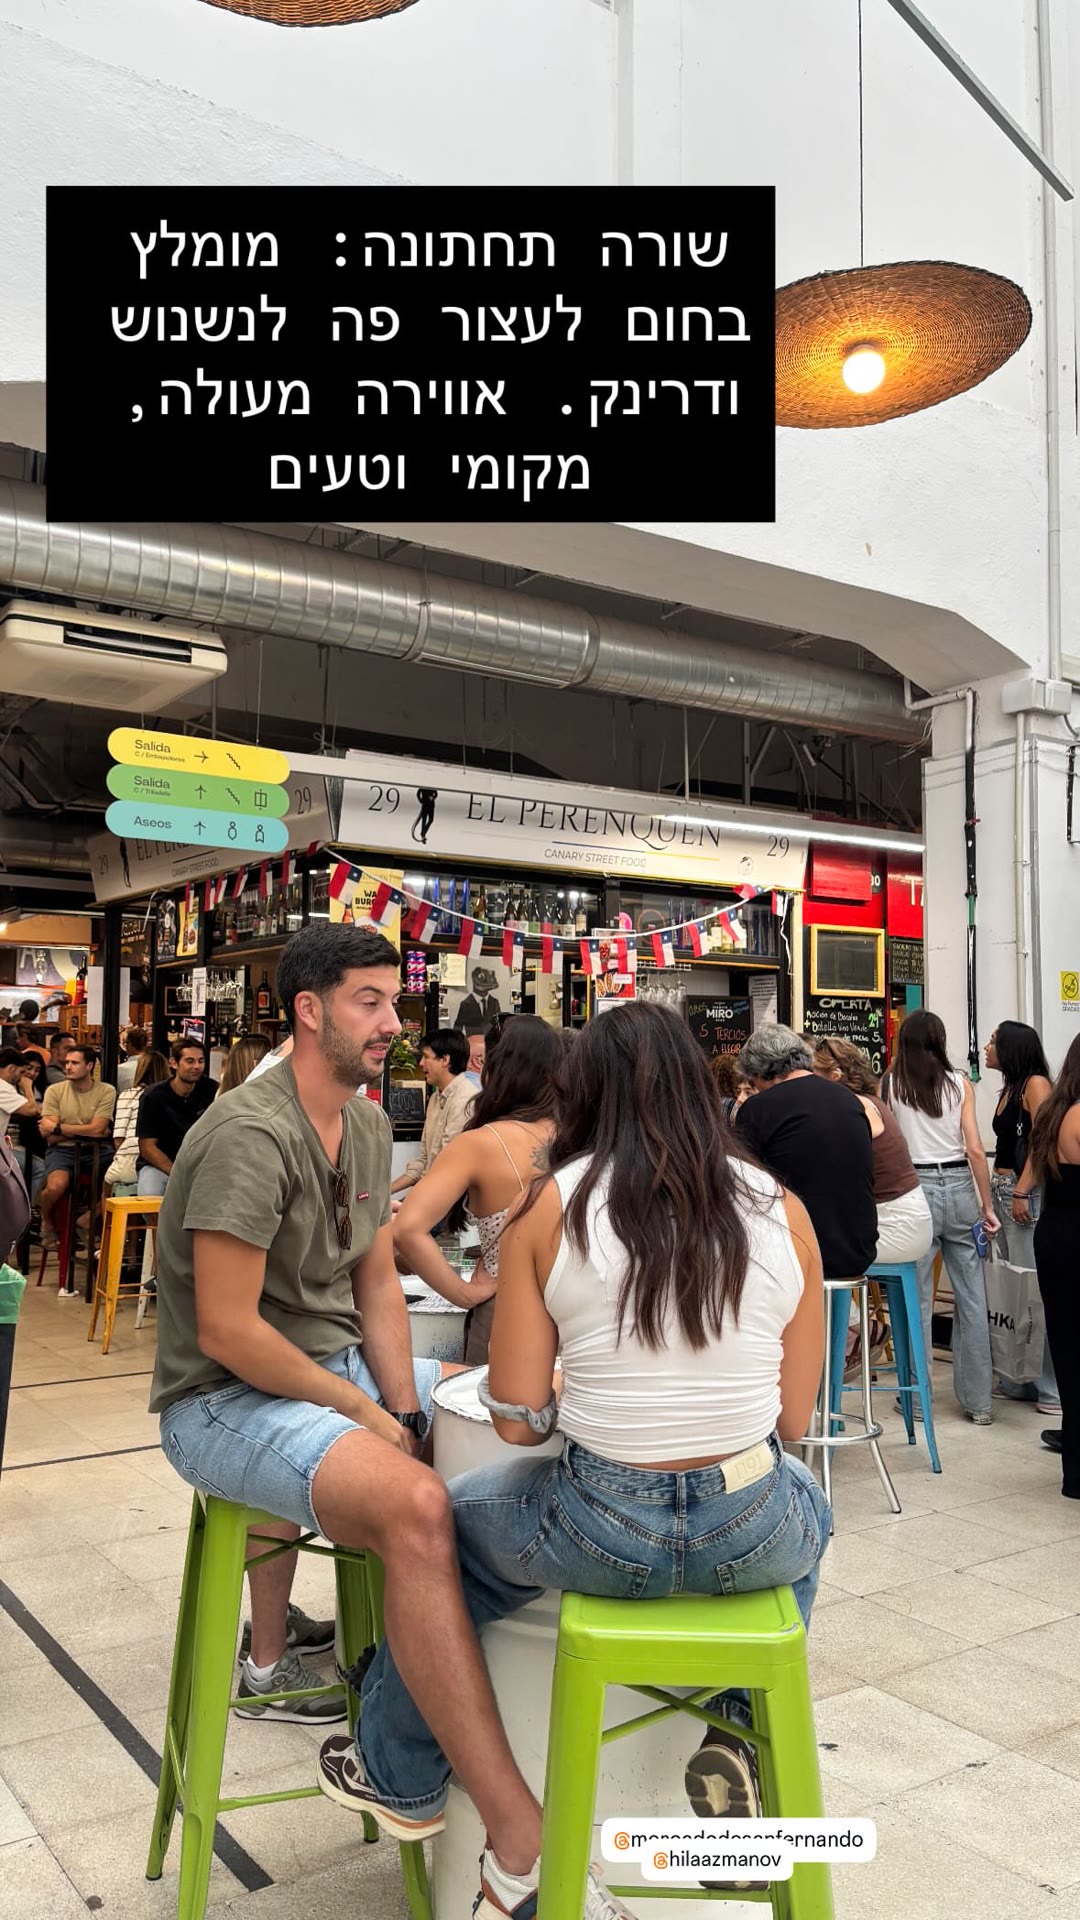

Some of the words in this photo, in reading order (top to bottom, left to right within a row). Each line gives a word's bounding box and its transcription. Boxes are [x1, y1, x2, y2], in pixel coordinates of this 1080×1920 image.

[135, 740, 171, 753] Salida
[134, 775, 170, 789] Salida
[294, 786, 311, 815] 29
[368, 785, 400, 814] 29
[134, 816, 172, 829] Aseos
[466, 793, 506, 823] EL
[517, 800, 721, 850] PERENQUEN
[766, 834, 790, 858] 29
[544, 848, 584, 861] CANARY
[585, 853, 621, 865] STREET
[620, 857, 647, 868] FOOD
[819, 998, 873, 1012] OFERTA
[706, 1008, 734, 1019] MIRO
[699, 1023, 709, 1038] 5
